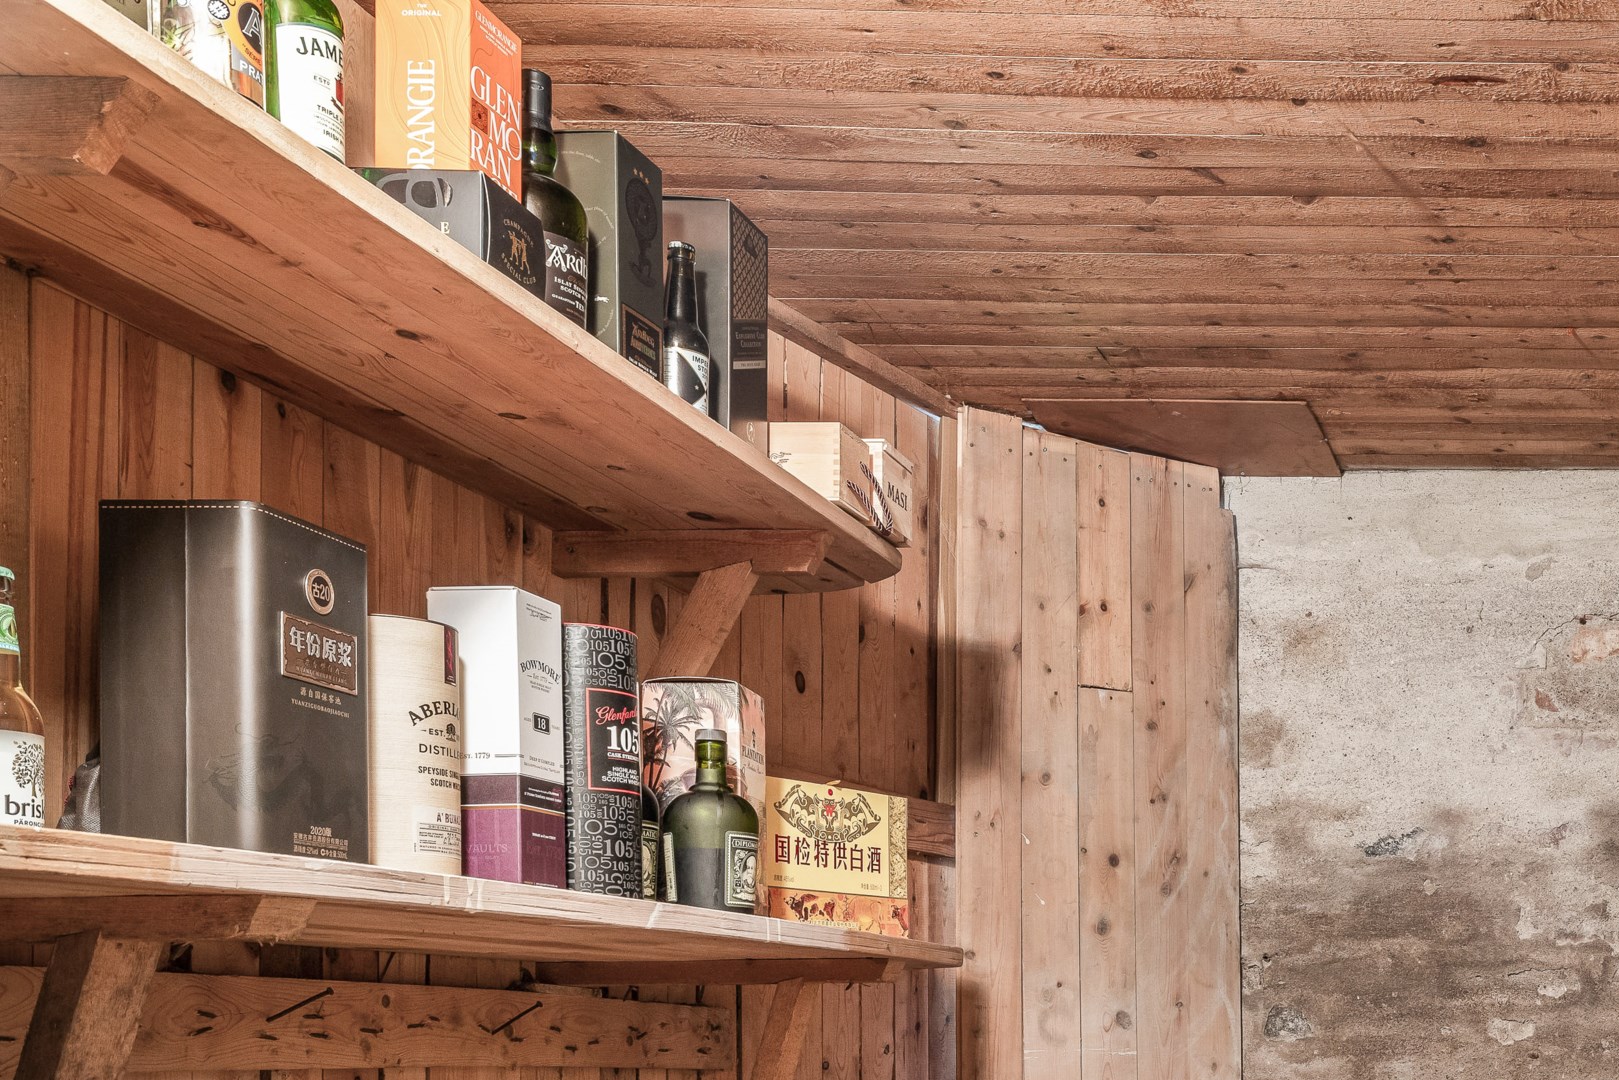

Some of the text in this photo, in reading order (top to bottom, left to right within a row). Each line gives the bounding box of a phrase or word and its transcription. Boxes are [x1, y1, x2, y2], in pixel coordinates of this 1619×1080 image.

[402, 9, 442, 17] ORIGINAL
[296, 36, 343, 68] JAME
[470, 65, 521, 131] GLEN
[406, 59, 435, 170] RANGIE
[489, 109, 522, 161] MO
[470, 128, 511, 187] RAN
[887, 482, 908, 511] MASI
[289, 626, 352, 667] 年份原浆
[590, 640, 609, 652] 105
[610, 640, 630, 656] 105
[592, 651, 626, 670] 105
[520, 660, 562, 684] BOWMORE
[537, 717, 546, 730] 18
[429, 728, 445, 737] EST.
[607, 725, 638, 755] 105
[475, 752, 491, 760] 1779
[418, 766, 448, 777] SPEYSIDE
[607, 771, 629, 779] SINGLE
[612, 766, 637, 775] HIGHLAND
[431, 778, 452, 789] SCOTCH
[578, 794, 597, 803] 105
[615, 795, 633, 808] 105
[579, 810, 596, 818] 105
[603, 806, 626, 821] 105
[578, 819, 618, 835] 105
[603, 839, 633, 858] 105
[775, 834, 881, 874] 国检特供白酒
[579, 856, 612, 868] 105
[612, 861, 630, 872] 105
[580, 870, 604, 881] 105
